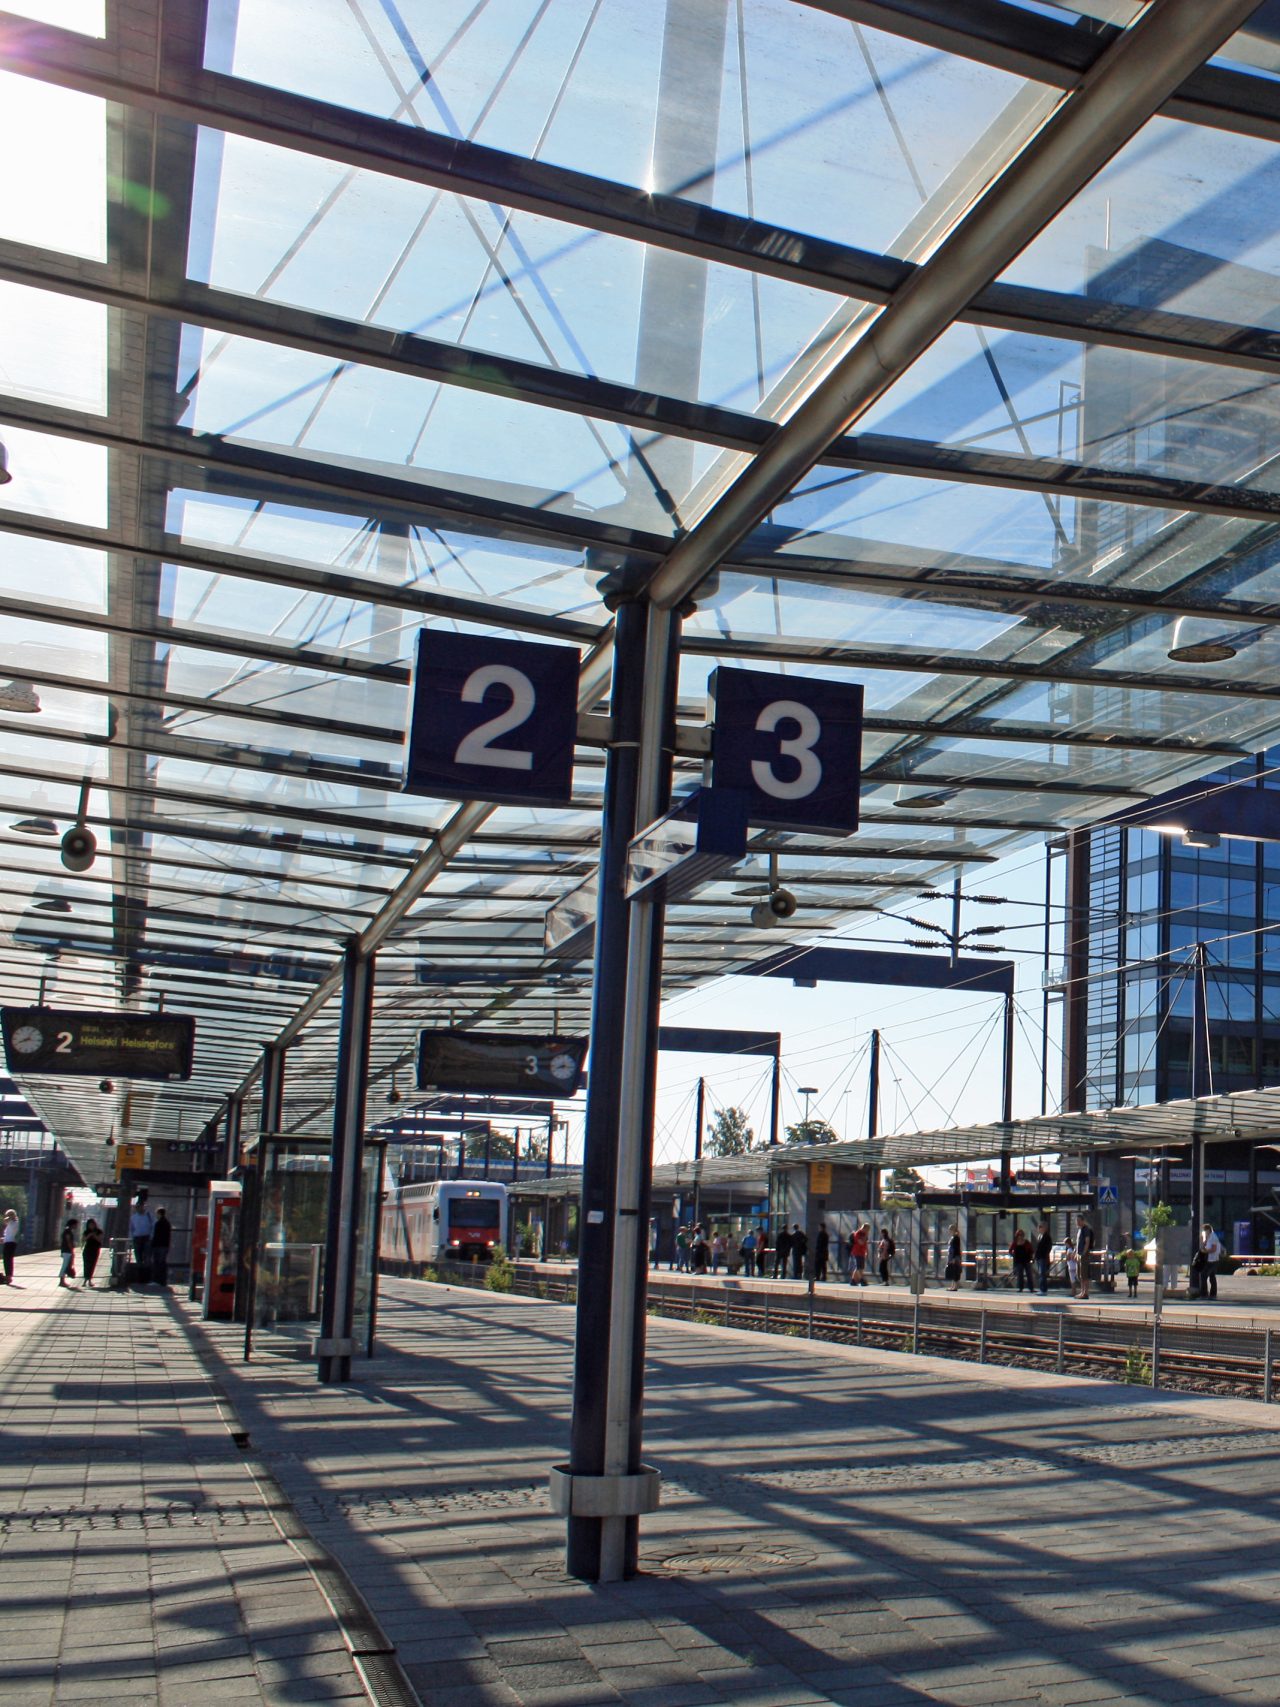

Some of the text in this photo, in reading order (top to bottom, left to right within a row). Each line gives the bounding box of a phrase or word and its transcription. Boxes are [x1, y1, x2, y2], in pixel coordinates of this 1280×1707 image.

[455, 664, 536, 770] 2
[751, 700, 822, 800] 3
[56, 1032, 73, 1053] 2
[80, 1035, 175, 1051] Helsinki Helsingfors
[524, 1055, 538, 1075] 3
